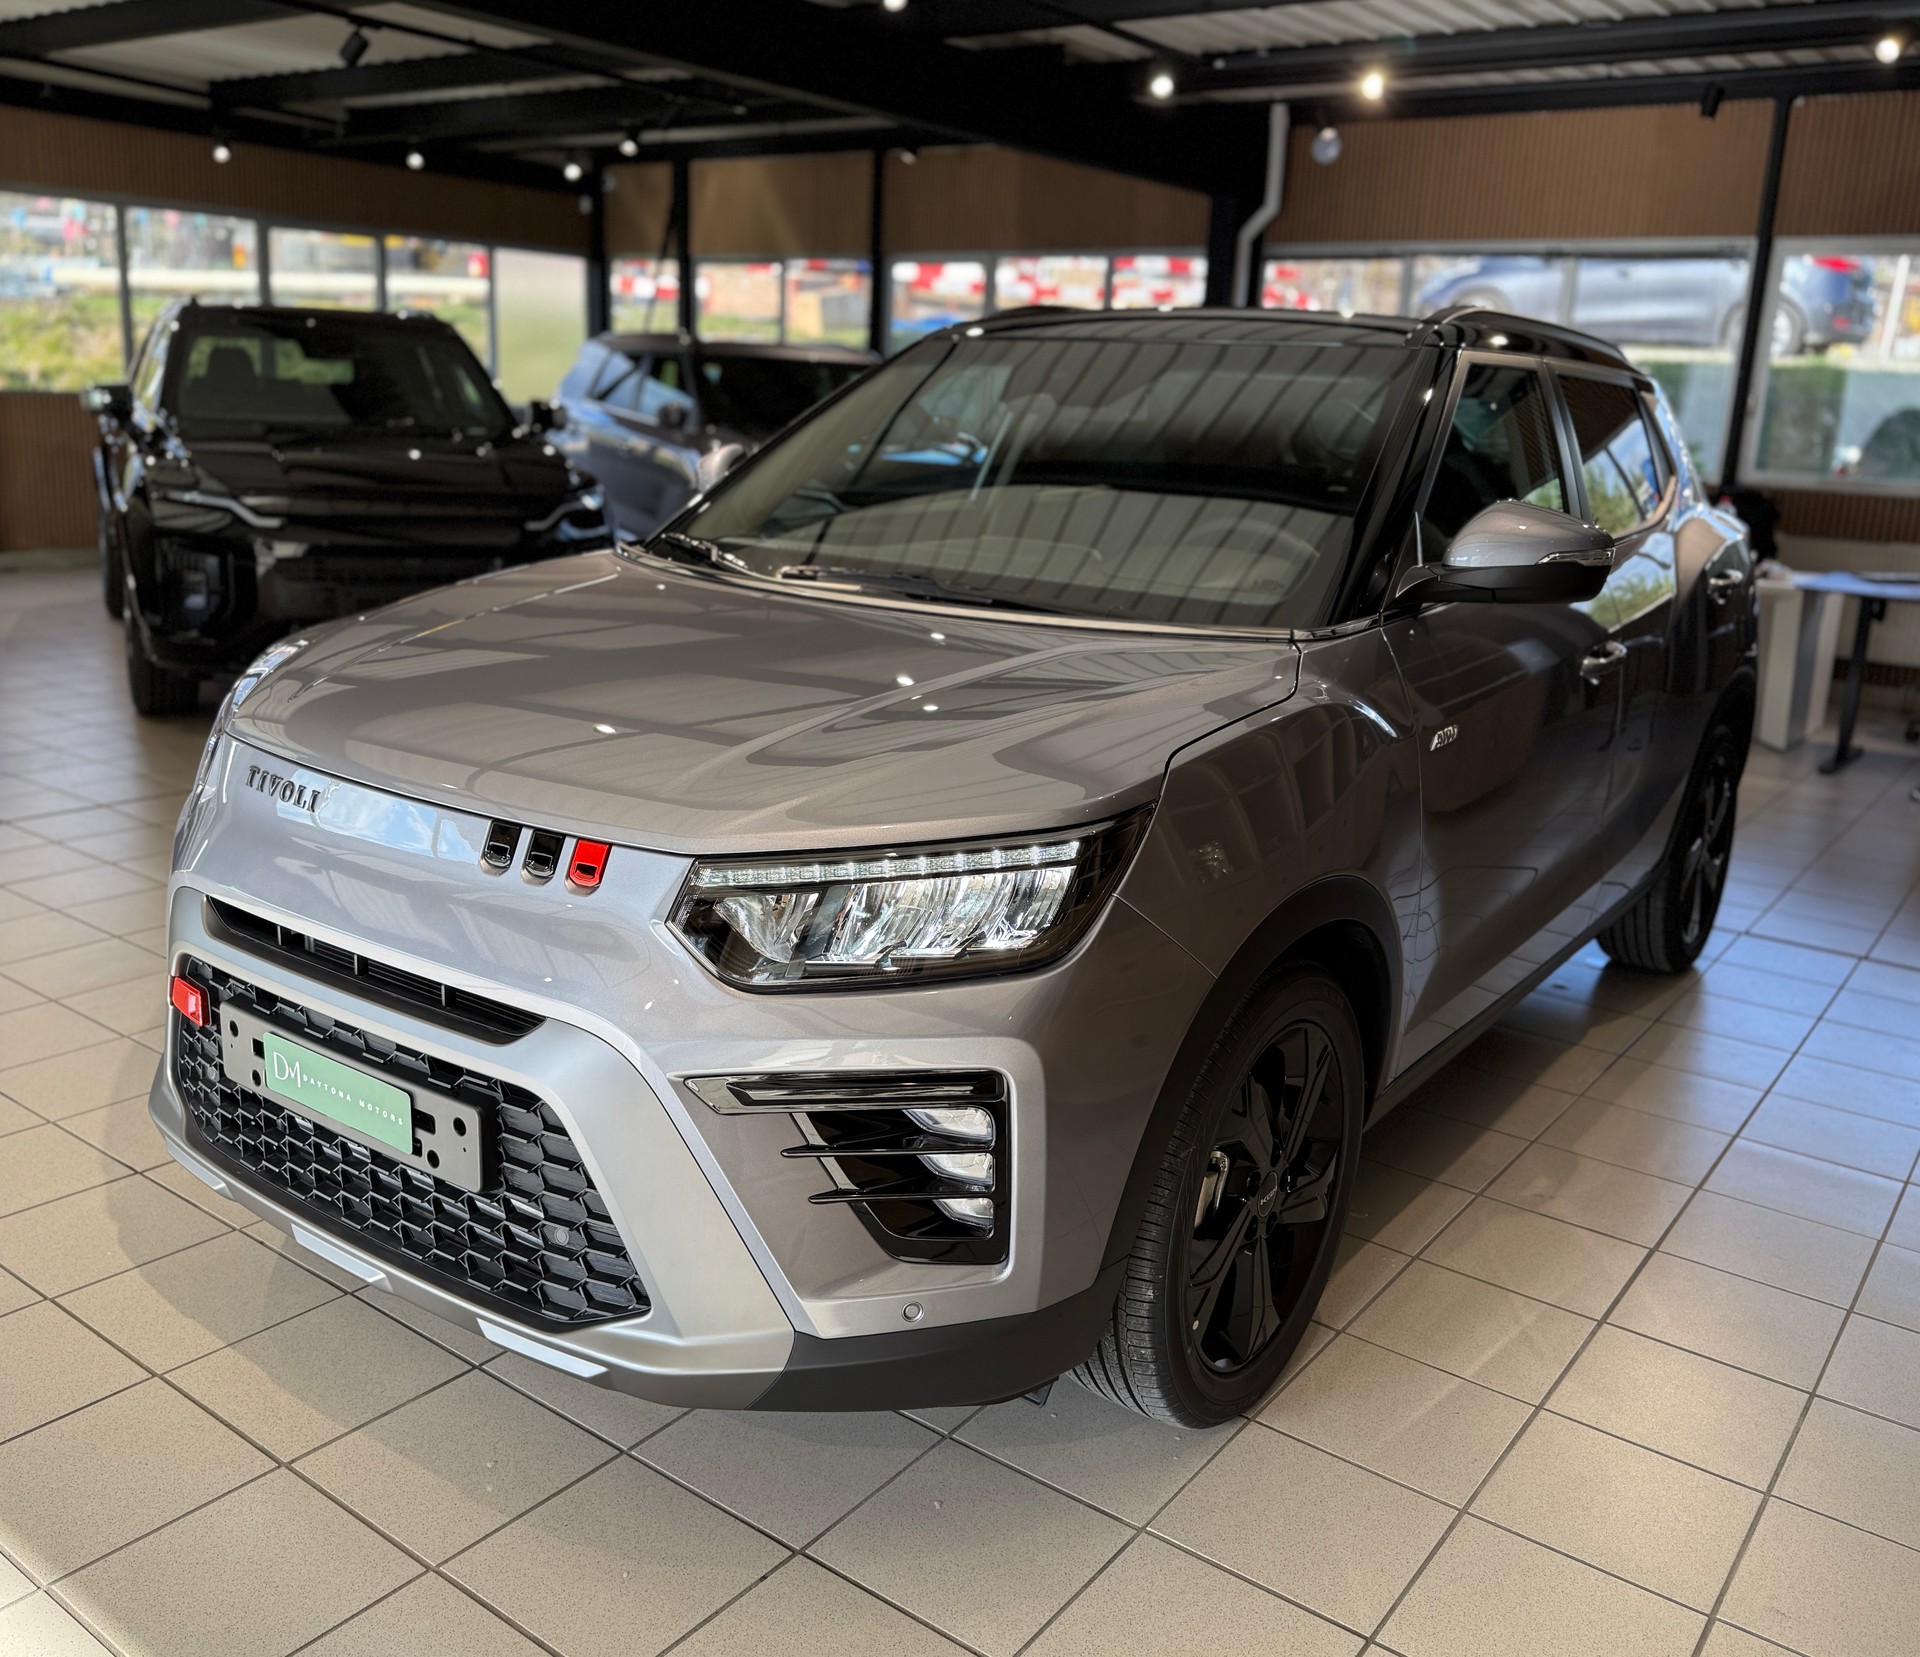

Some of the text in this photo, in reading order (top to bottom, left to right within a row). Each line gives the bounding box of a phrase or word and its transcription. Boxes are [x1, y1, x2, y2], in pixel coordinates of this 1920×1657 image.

[245, 764, 320, 813] TIVOLI
[303, 1074, 404, 1126] DAYTONA MOTORS
